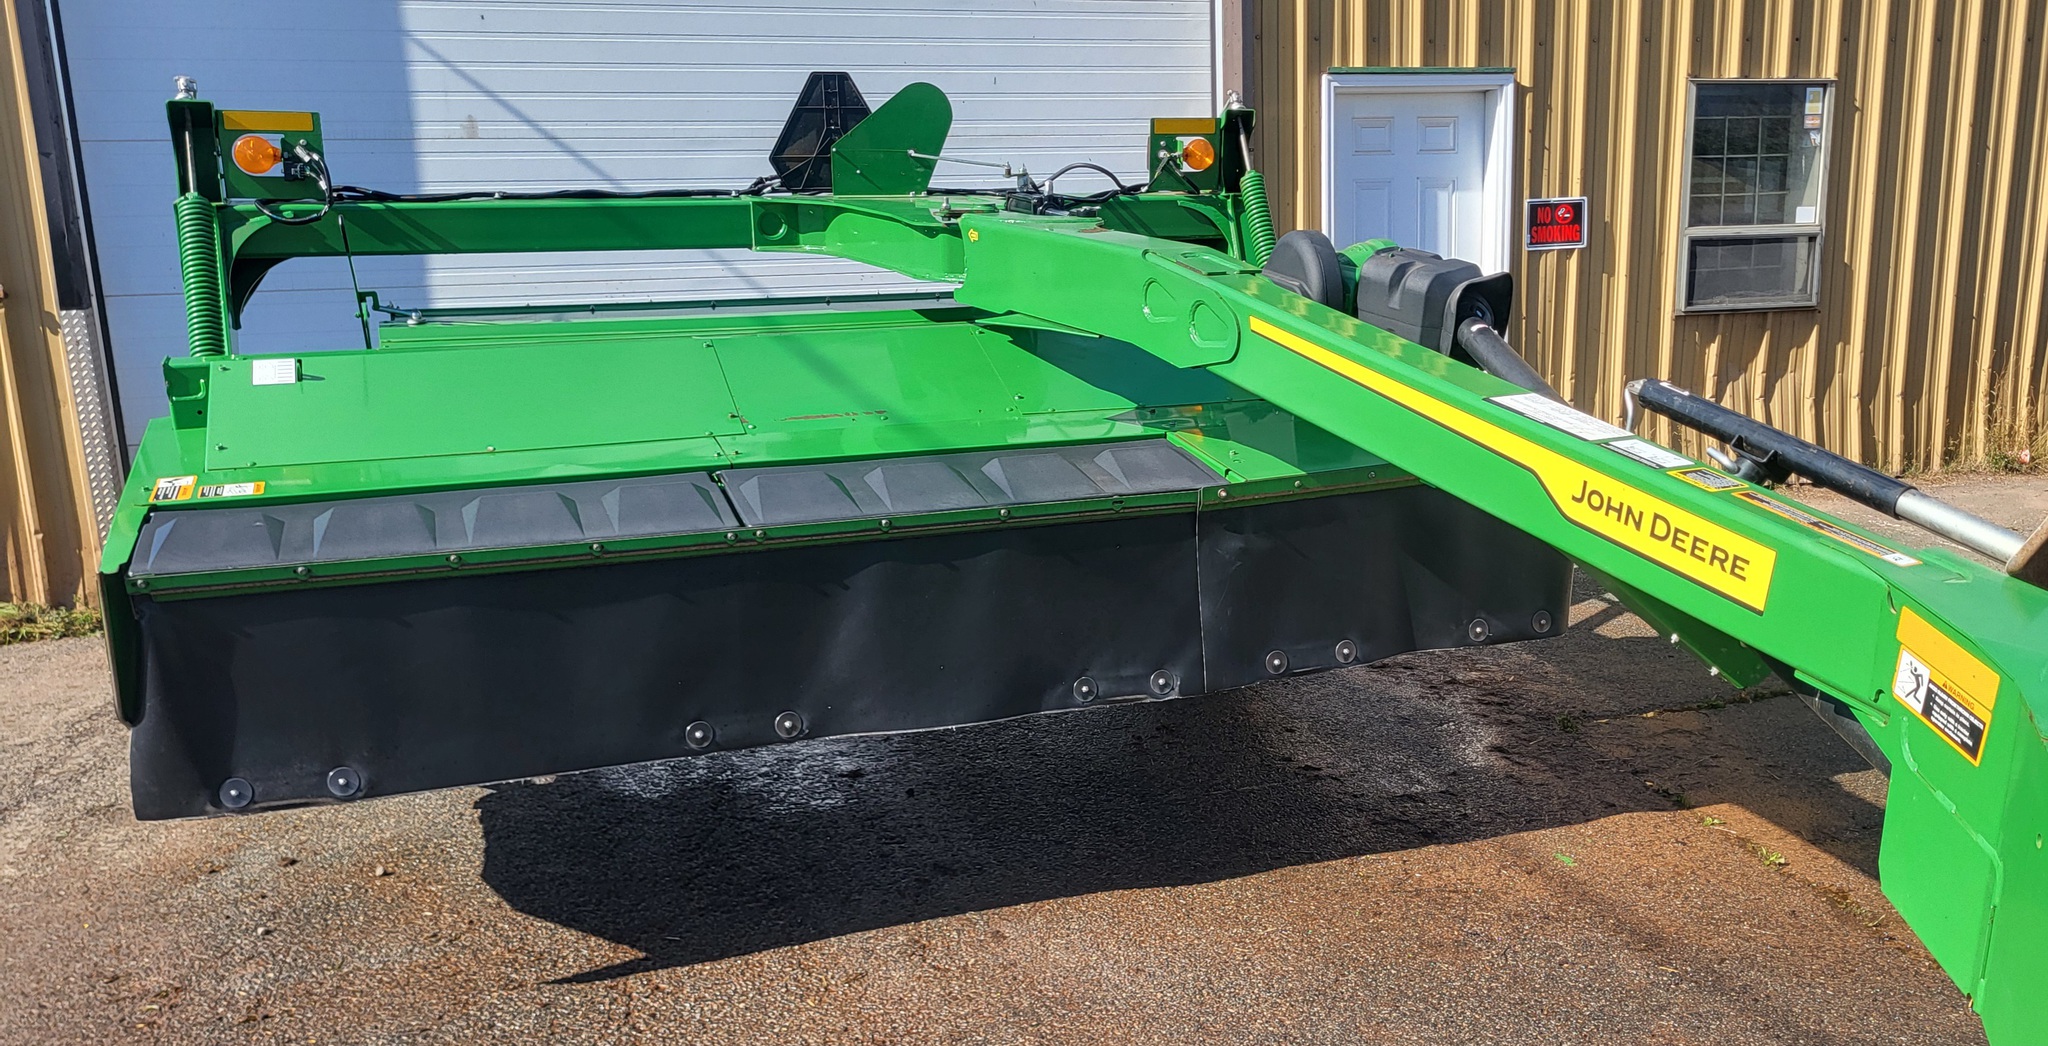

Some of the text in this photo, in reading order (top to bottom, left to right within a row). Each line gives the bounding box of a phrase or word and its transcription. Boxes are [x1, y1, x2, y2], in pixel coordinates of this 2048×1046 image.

[1537, 206, 1552, 224] NO
[1531, 224, 1580, 243] SMOKING
[1571, 480, 1644, 532] JOHN
[1649, 512, 1750, 582] DEERE
[1946, 685, 1975, 711] WARNING
